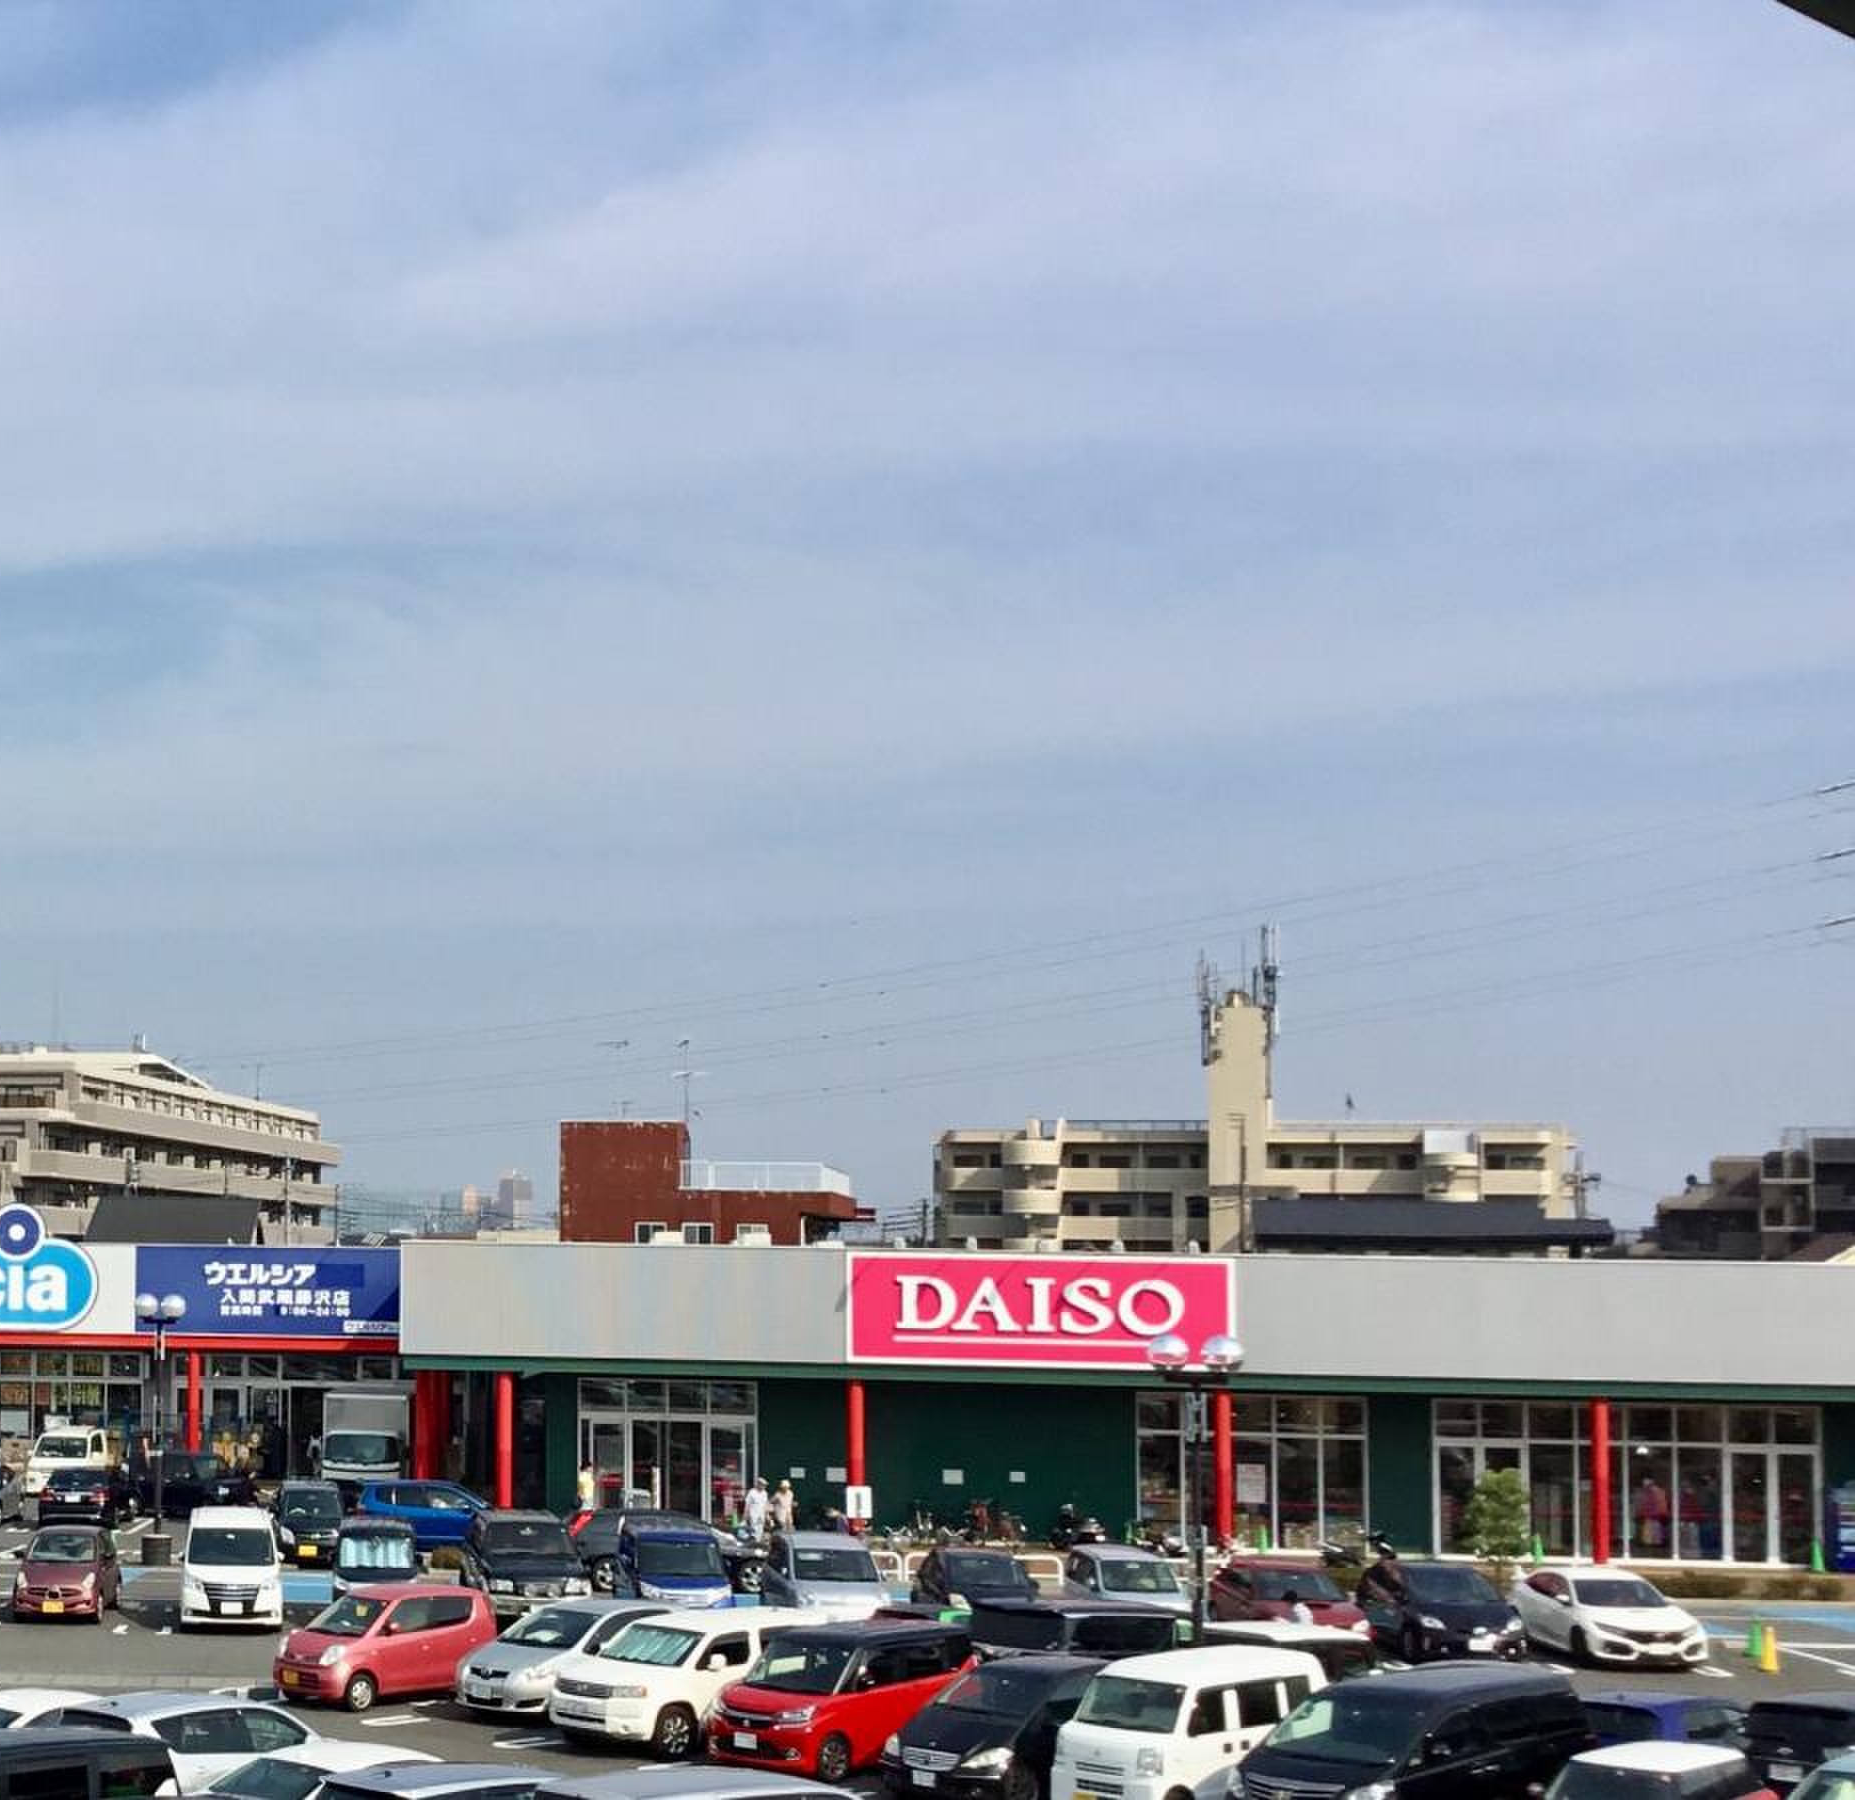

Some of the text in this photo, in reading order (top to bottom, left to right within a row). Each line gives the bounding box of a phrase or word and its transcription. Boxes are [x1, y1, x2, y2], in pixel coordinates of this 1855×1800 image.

[203, 1262, 316, 1286] ウエルシア
[895, 1275, 1185, 1335] DAISO
